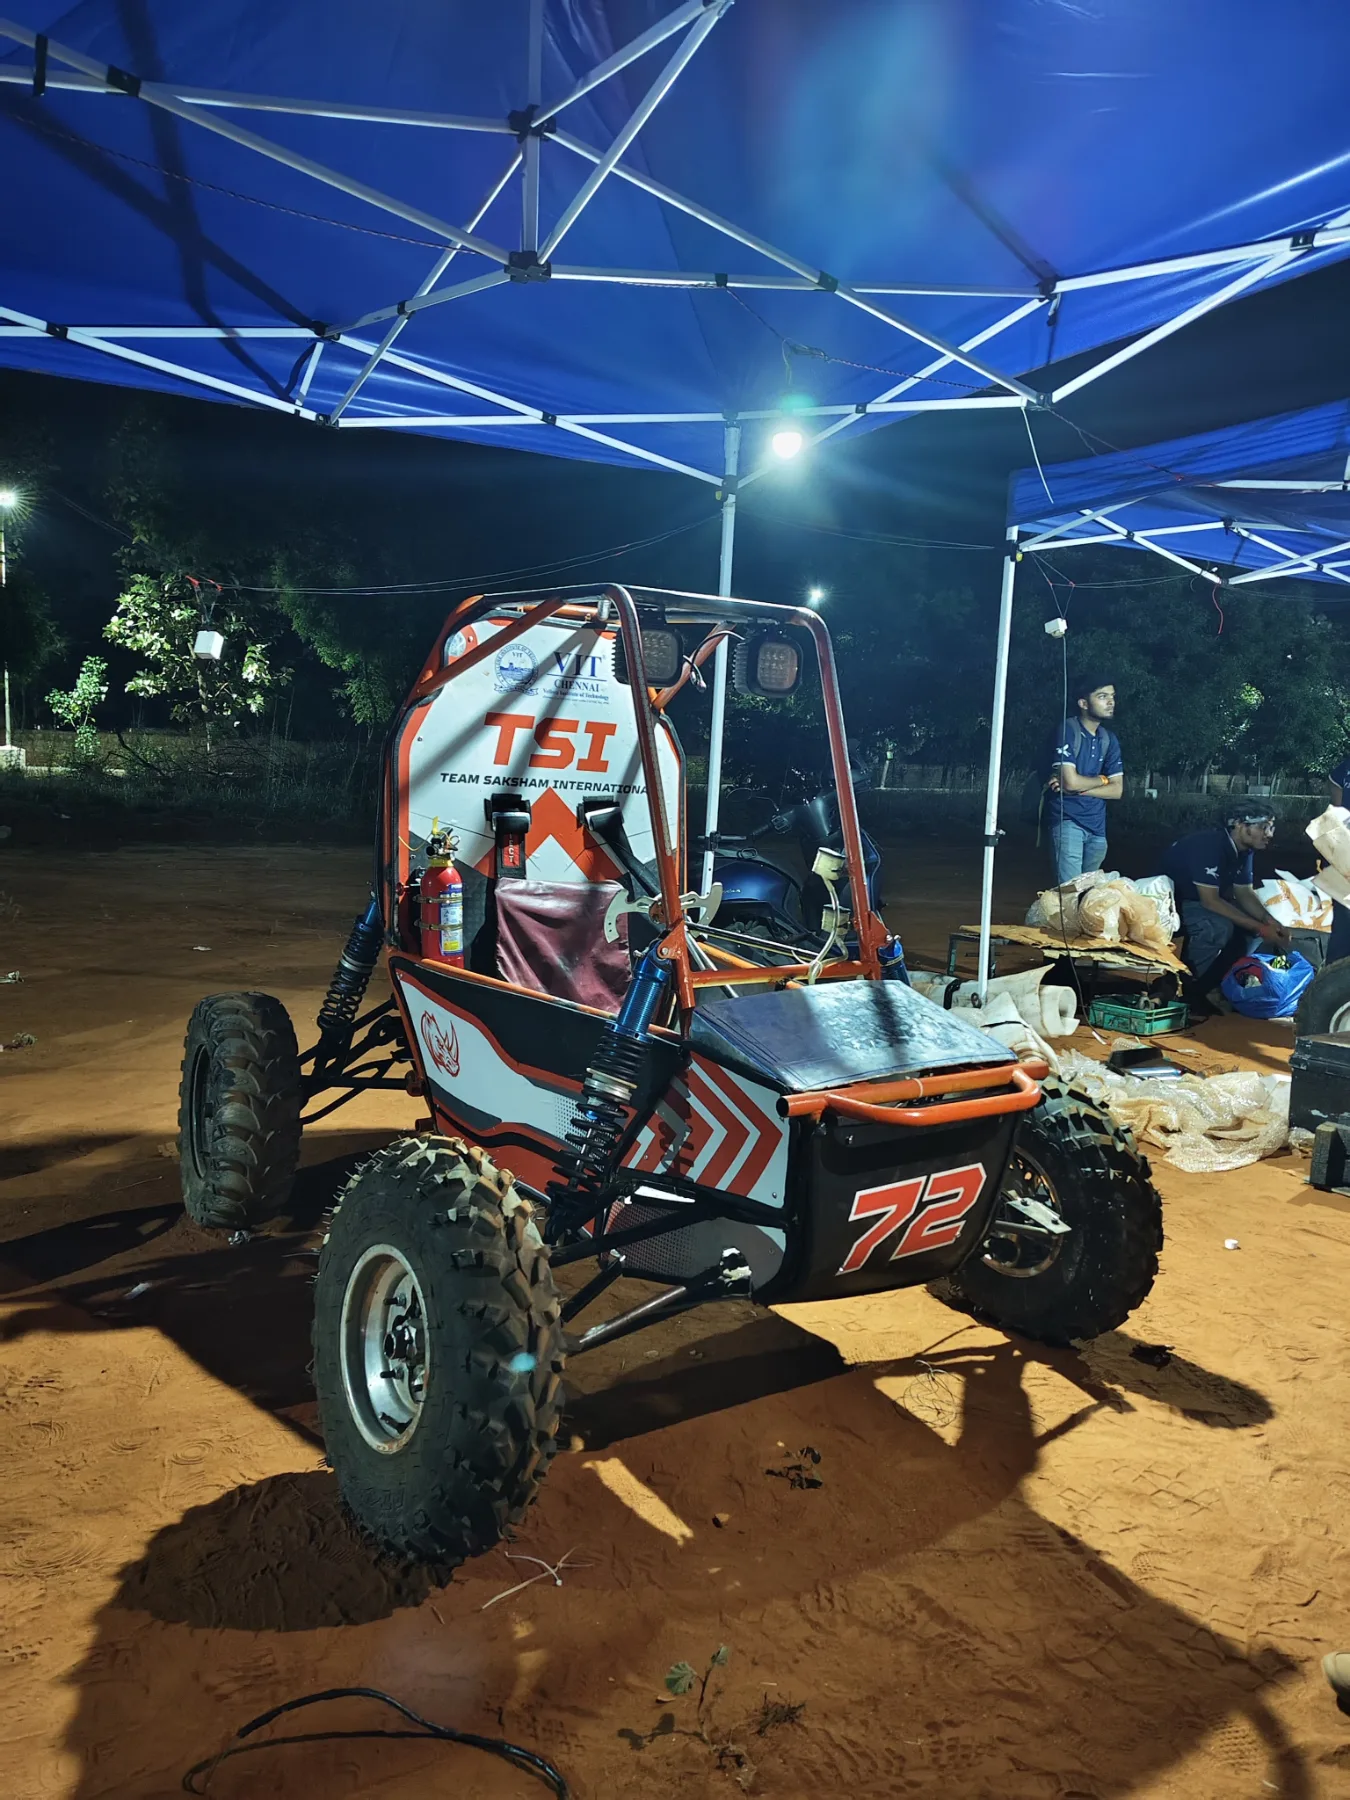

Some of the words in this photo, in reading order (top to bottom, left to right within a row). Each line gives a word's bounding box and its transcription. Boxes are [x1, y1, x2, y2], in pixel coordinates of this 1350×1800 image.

[553, 651, 602, 678] VIT
[554, 679, 600, 692] CHENNAI
[484, 711, 618, 773] TSI
[439, 772, 480, 785] TEAM
[483, 775, 550, 789] SAKSHAM
[551, 779, 648, 794] INTERNATIONA
[834, 1162, 987, 1277] 72
